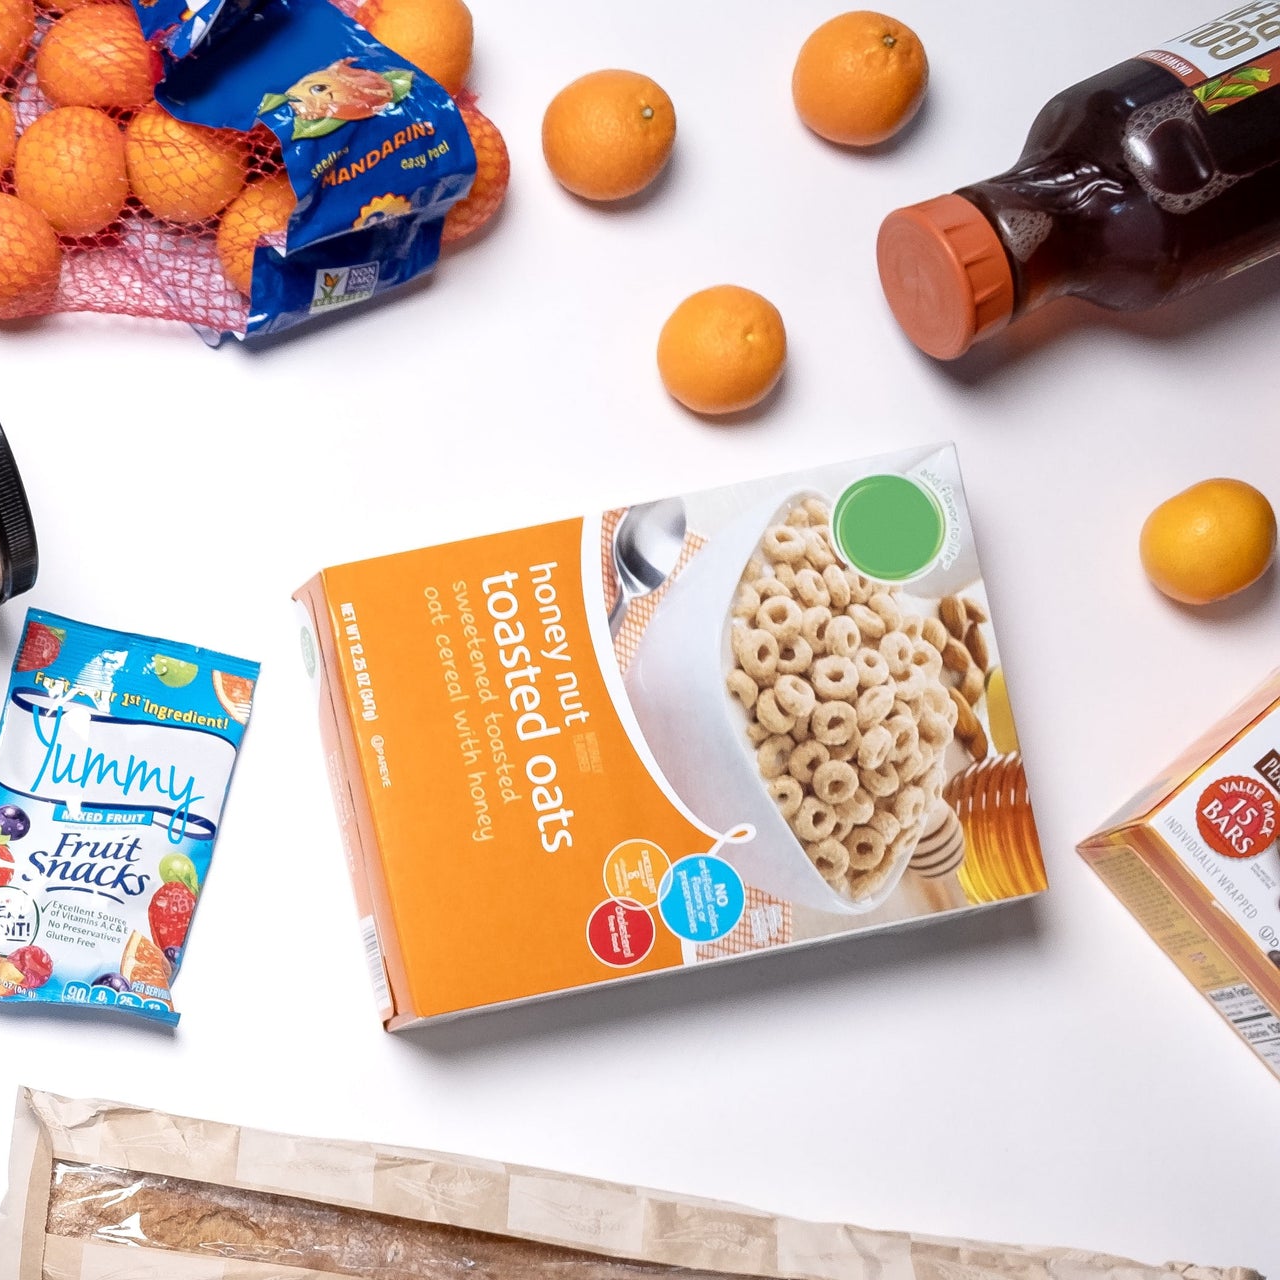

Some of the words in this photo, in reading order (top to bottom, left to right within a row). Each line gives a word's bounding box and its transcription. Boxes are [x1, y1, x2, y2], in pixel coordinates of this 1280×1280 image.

[321, 120, 435, 187] MANDARINS
[401, 152, 432, 171] easy
[341, 602, 355, 621] NET
[424, 586, 448, 624] oat
[346, 623, 360, 640] WT
[530, 562, 570, 660] honey
[555, 672, 589, 725] nut
[350, 643, 366, 671] 12.25
[435, 634, 468, 701] cereal
[356, 672, 370, 687] OZ
[453, 581, 497, 702] sweetened
[484, 712, 521, 802] toasted
[144, 699, 230, 728] Ingredient!
[359, 688, 377, 720] (347g)
[483, 572, 558, 739] toasted
[526, 755, 572, 851] oats
[454, 710, 480, 764] with
[31, 706, 205, 844] Yummy
[106, 813, 144, 828] FRUIT
[463, 771, 496, 842] honey
[1219, 780, 1265, 800] VALUE
[1259, 800, 1275, 838] PACK
[1229, 798, 1259, 826] 15
[1202, 798, 1255, 854] BARS
[53, 832, 140, 868] Fruit
[1165, 815, 1221, 879] INDIVIDUALLY
[1217, 875, 1258, 919] WRAPPED
[22, 851, 149, 895] Snacks
[714, 883, 728, 906] NO
[52, 900, 94, 917] Excellent
[97, 911, 126, 925] Source
[62, 911, 100, 925] Vitamins
[45, 930, 74, 942] Gluten
[76, 937, 95, 948] Free
[62, 923, 120, 943] Preservatives
